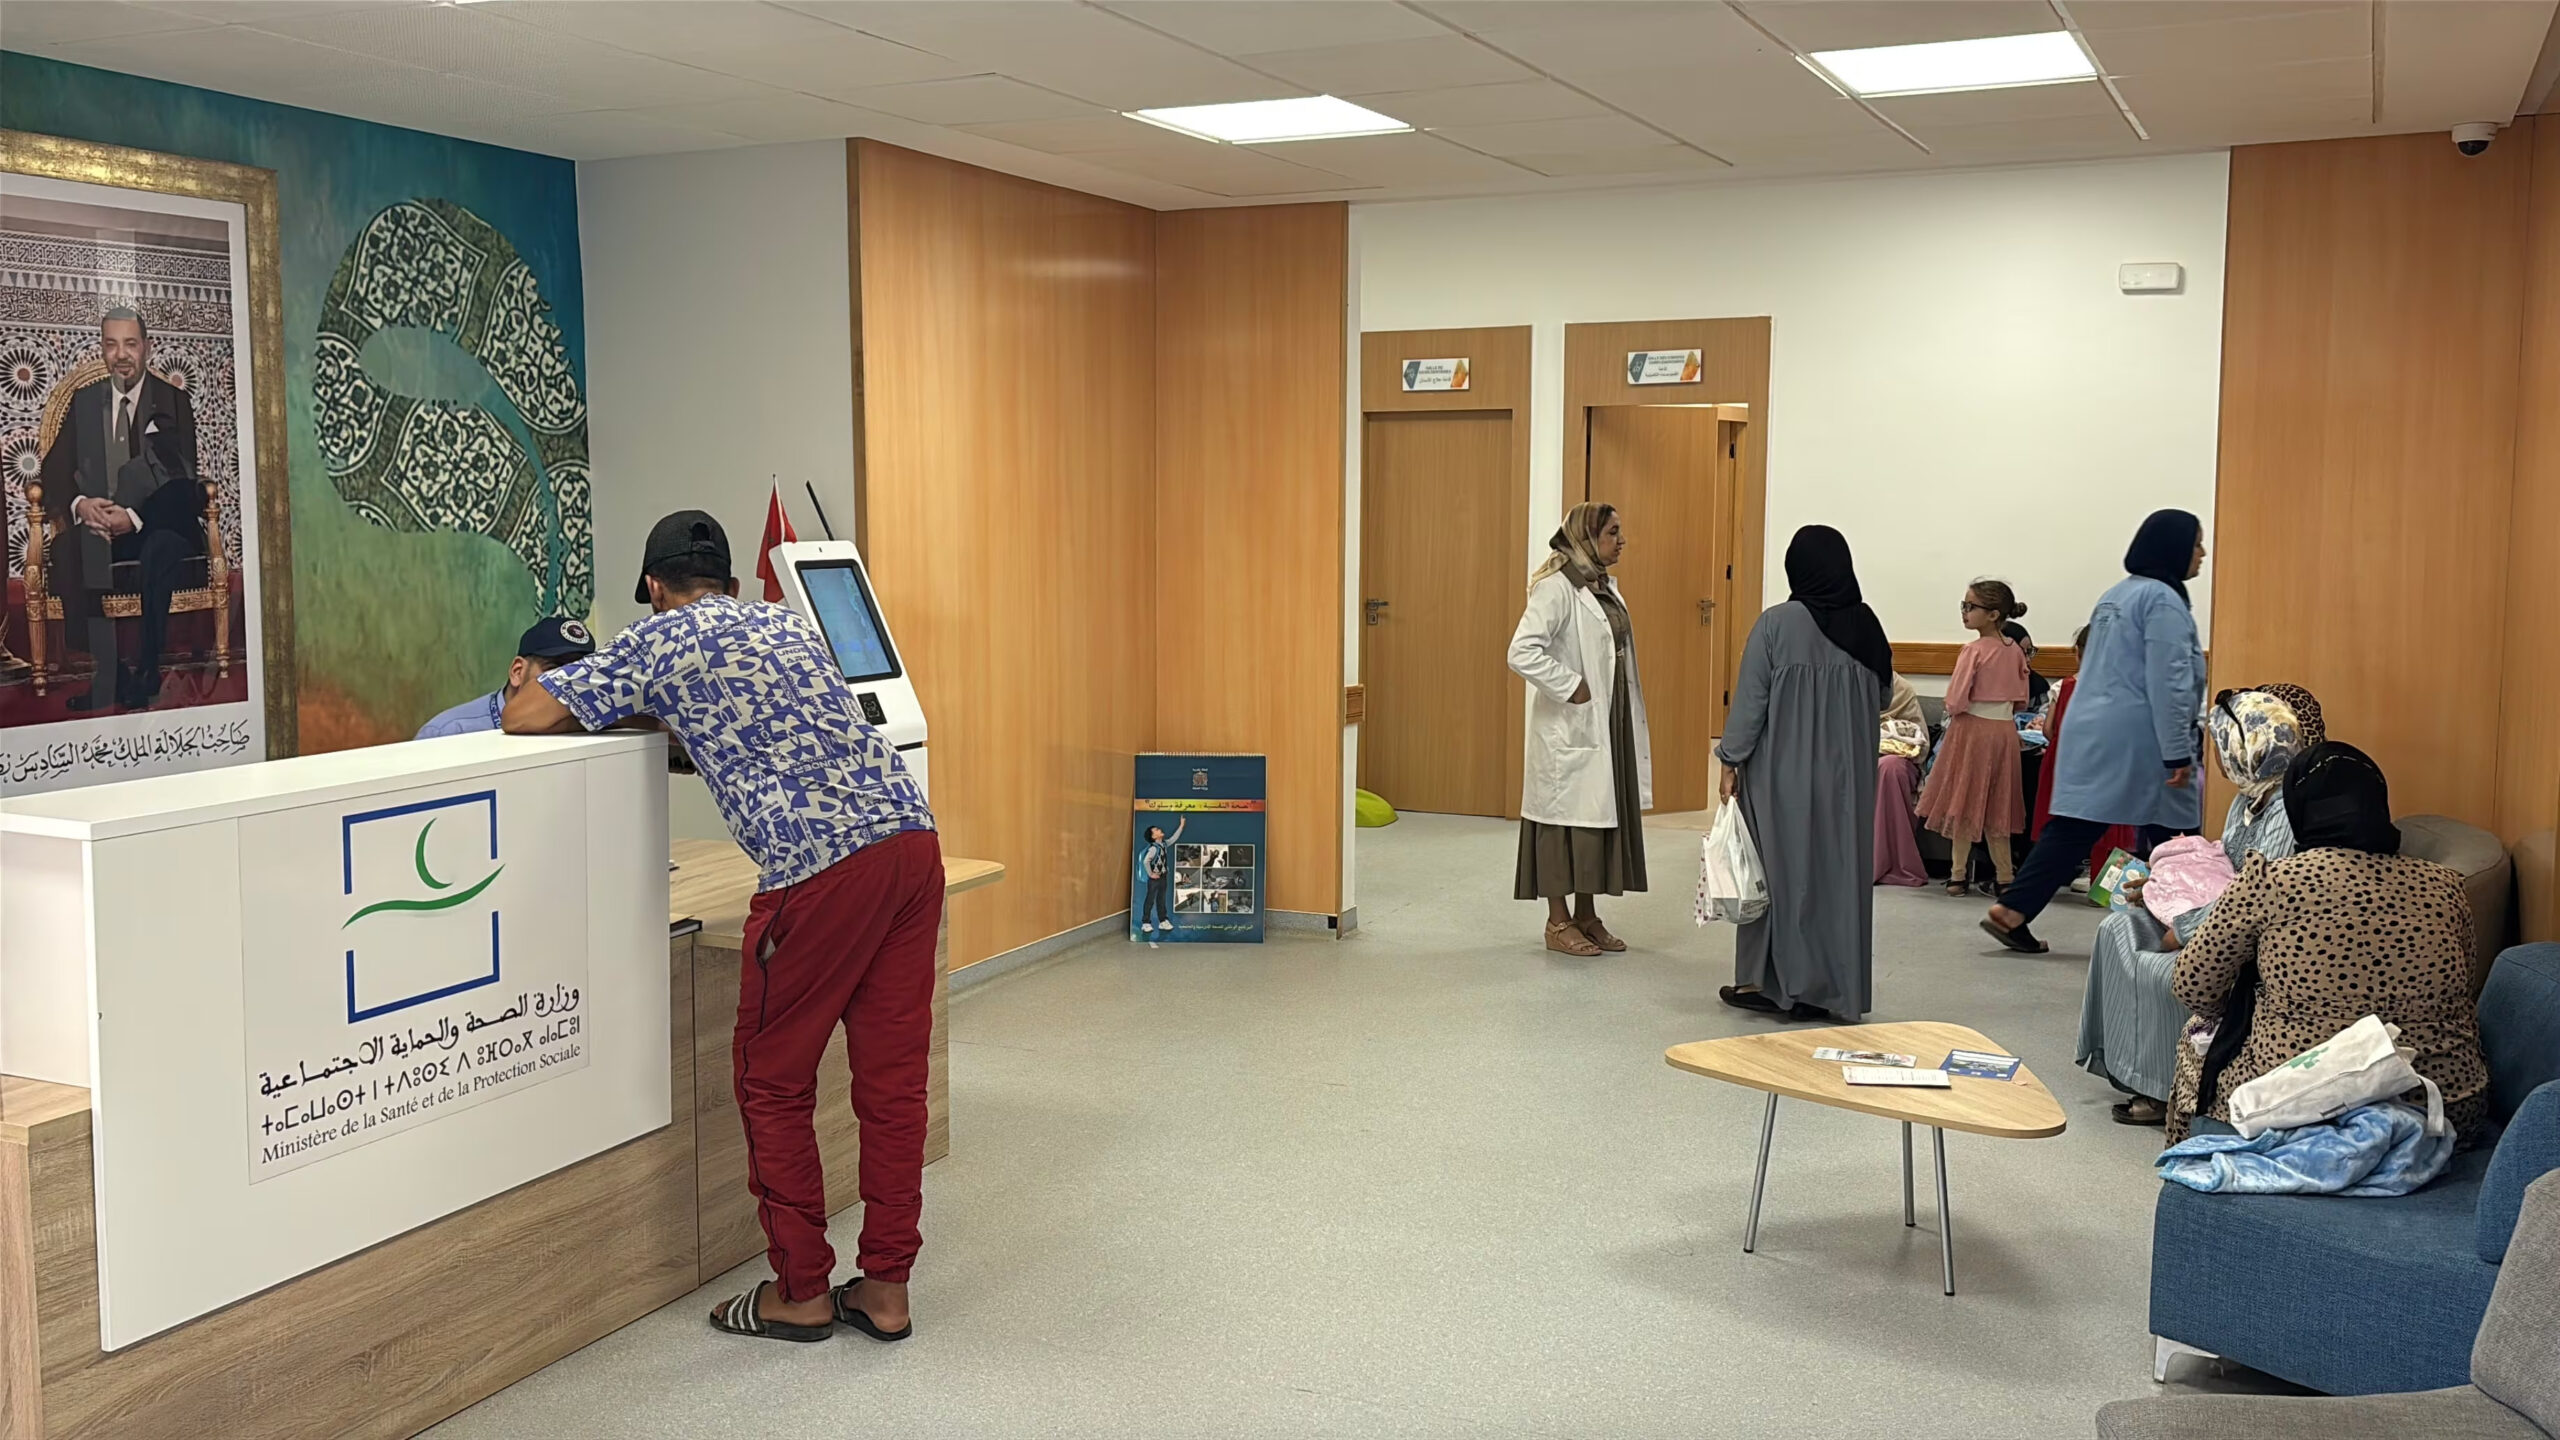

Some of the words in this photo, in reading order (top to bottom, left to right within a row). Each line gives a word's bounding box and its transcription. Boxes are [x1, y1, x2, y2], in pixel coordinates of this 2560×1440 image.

[561, 684, 596, 719] UNDER
[465, 992, 529, 1033] الصحة
[534, 983, 580, 1018] وزارة
[389, 1015, 460, 1059] والحماية
[258, 1035, 384, 1099] الاجتماعية
[261, 1127, 337, 1164] Ministère
[340, 1119, 360, 1138] de
[362, 1112, 377, 1130] la
[379, 1096, 419, 1124] Santé
[421, 1092, 435, 1108] et
[437, 1086, 455, 1103] de
[457, 1081, 470, 1098] la
[473, 1060, 537, 1092] Protection
[539, 1043, 581, 1070] Sociale
